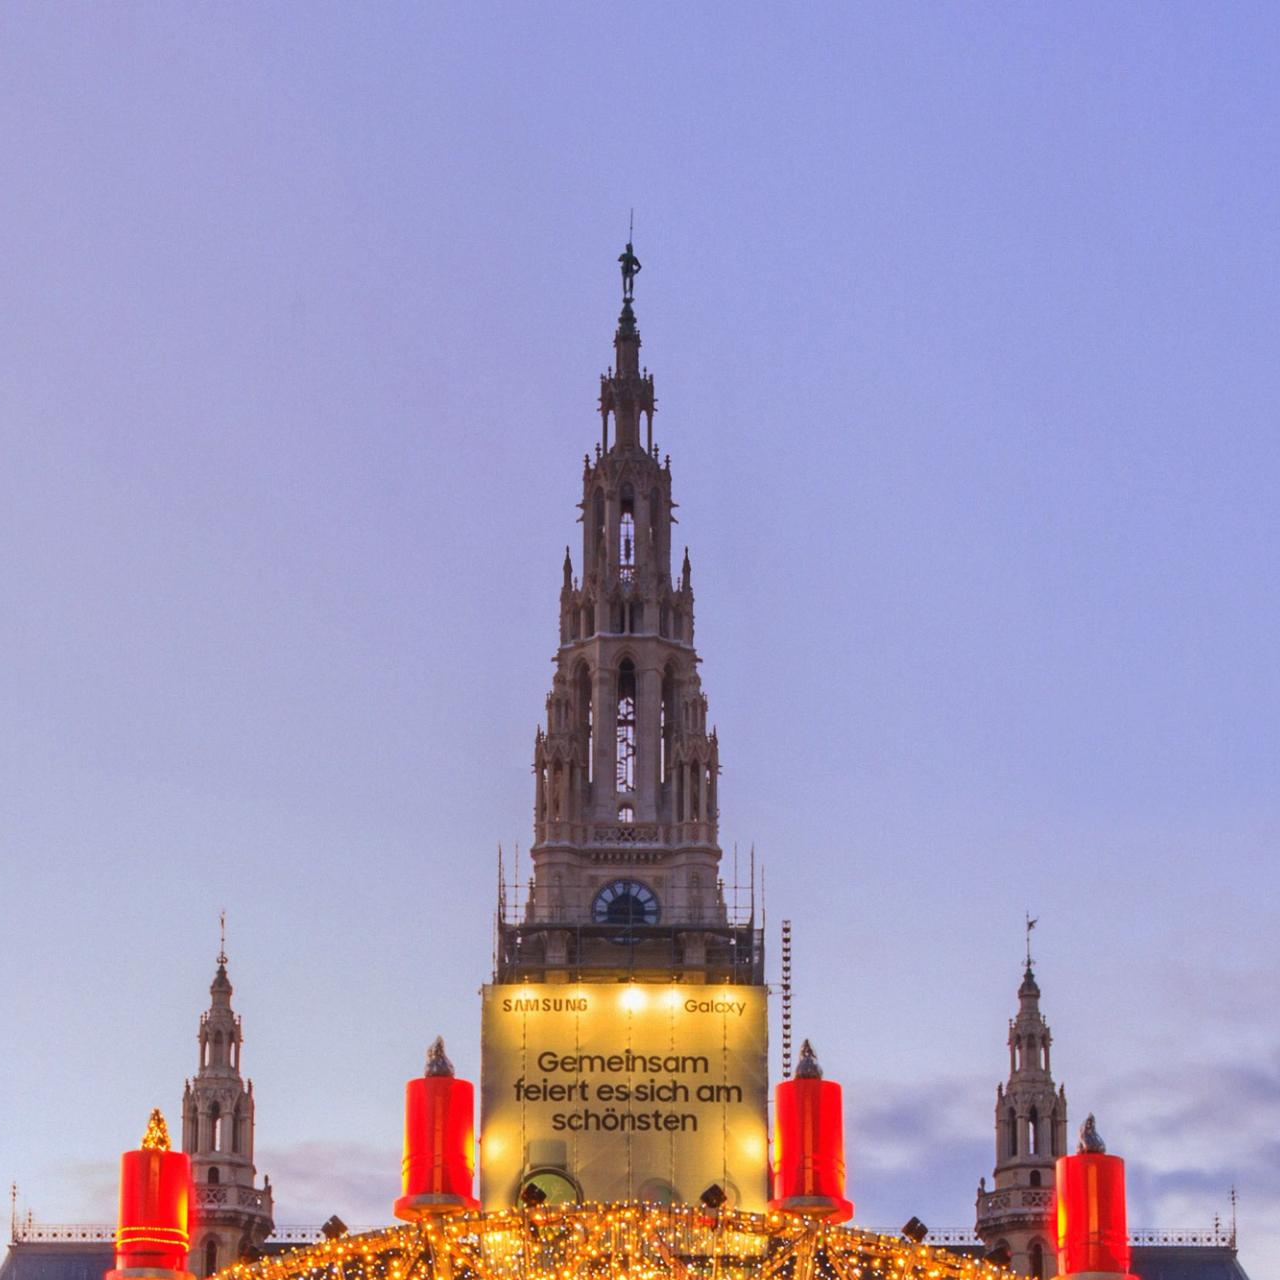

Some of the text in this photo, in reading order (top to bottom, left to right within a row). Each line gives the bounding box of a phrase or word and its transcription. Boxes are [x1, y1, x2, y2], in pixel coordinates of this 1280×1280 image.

[502, 997, 588, 1012] SAMSUNG
[684, 999, 746, 1016] Galaxy
[537, 1049, 709, 1073] Gemeinsam
[514, 1078, 742, 1103] feiert es sich am
[552, 1108, 697, 1131] schönsten
